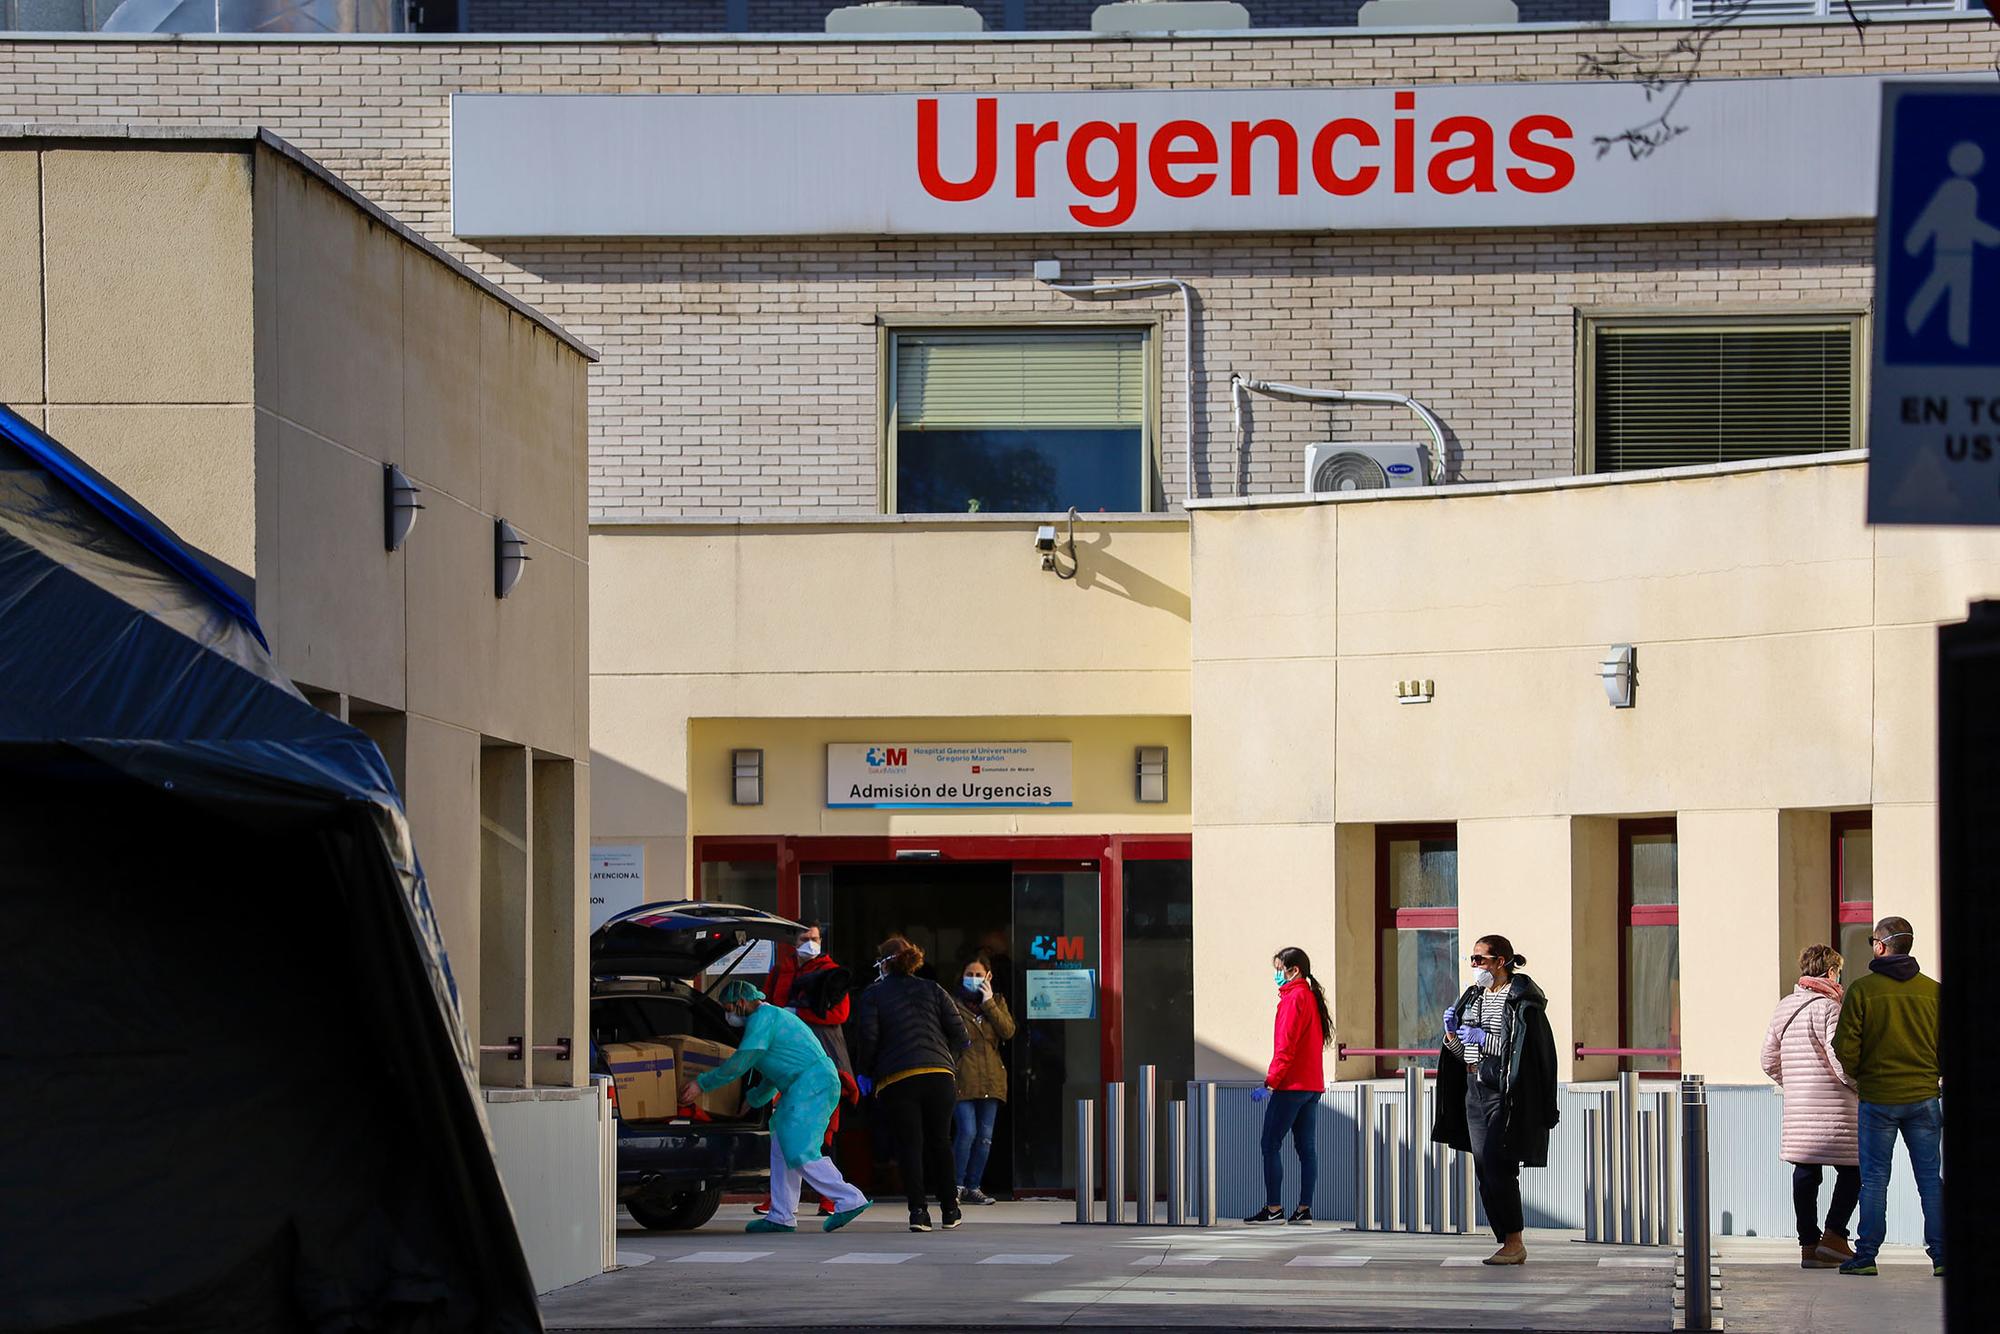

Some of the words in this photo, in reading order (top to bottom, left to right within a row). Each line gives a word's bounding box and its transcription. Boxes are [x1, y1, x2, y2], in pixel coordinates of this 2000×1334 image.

[917, 91, 1575, 228] Urgencias
[1901, 396, 1948, 425] EN
[1944, 433, 2000, 462] US
[913, 747, 946, 755] Hospital
[947, 747, 977, 755] General
[978, 747, 1028, 755] Universitario
[936, 754, 971, 762] Gregorio
[971, 754, 1005, 762] Marañón
[850, 783, 931, 798] Admisión
[936, 783, 957, 798] de
[962, 783, 1052, 801] Urgencias
